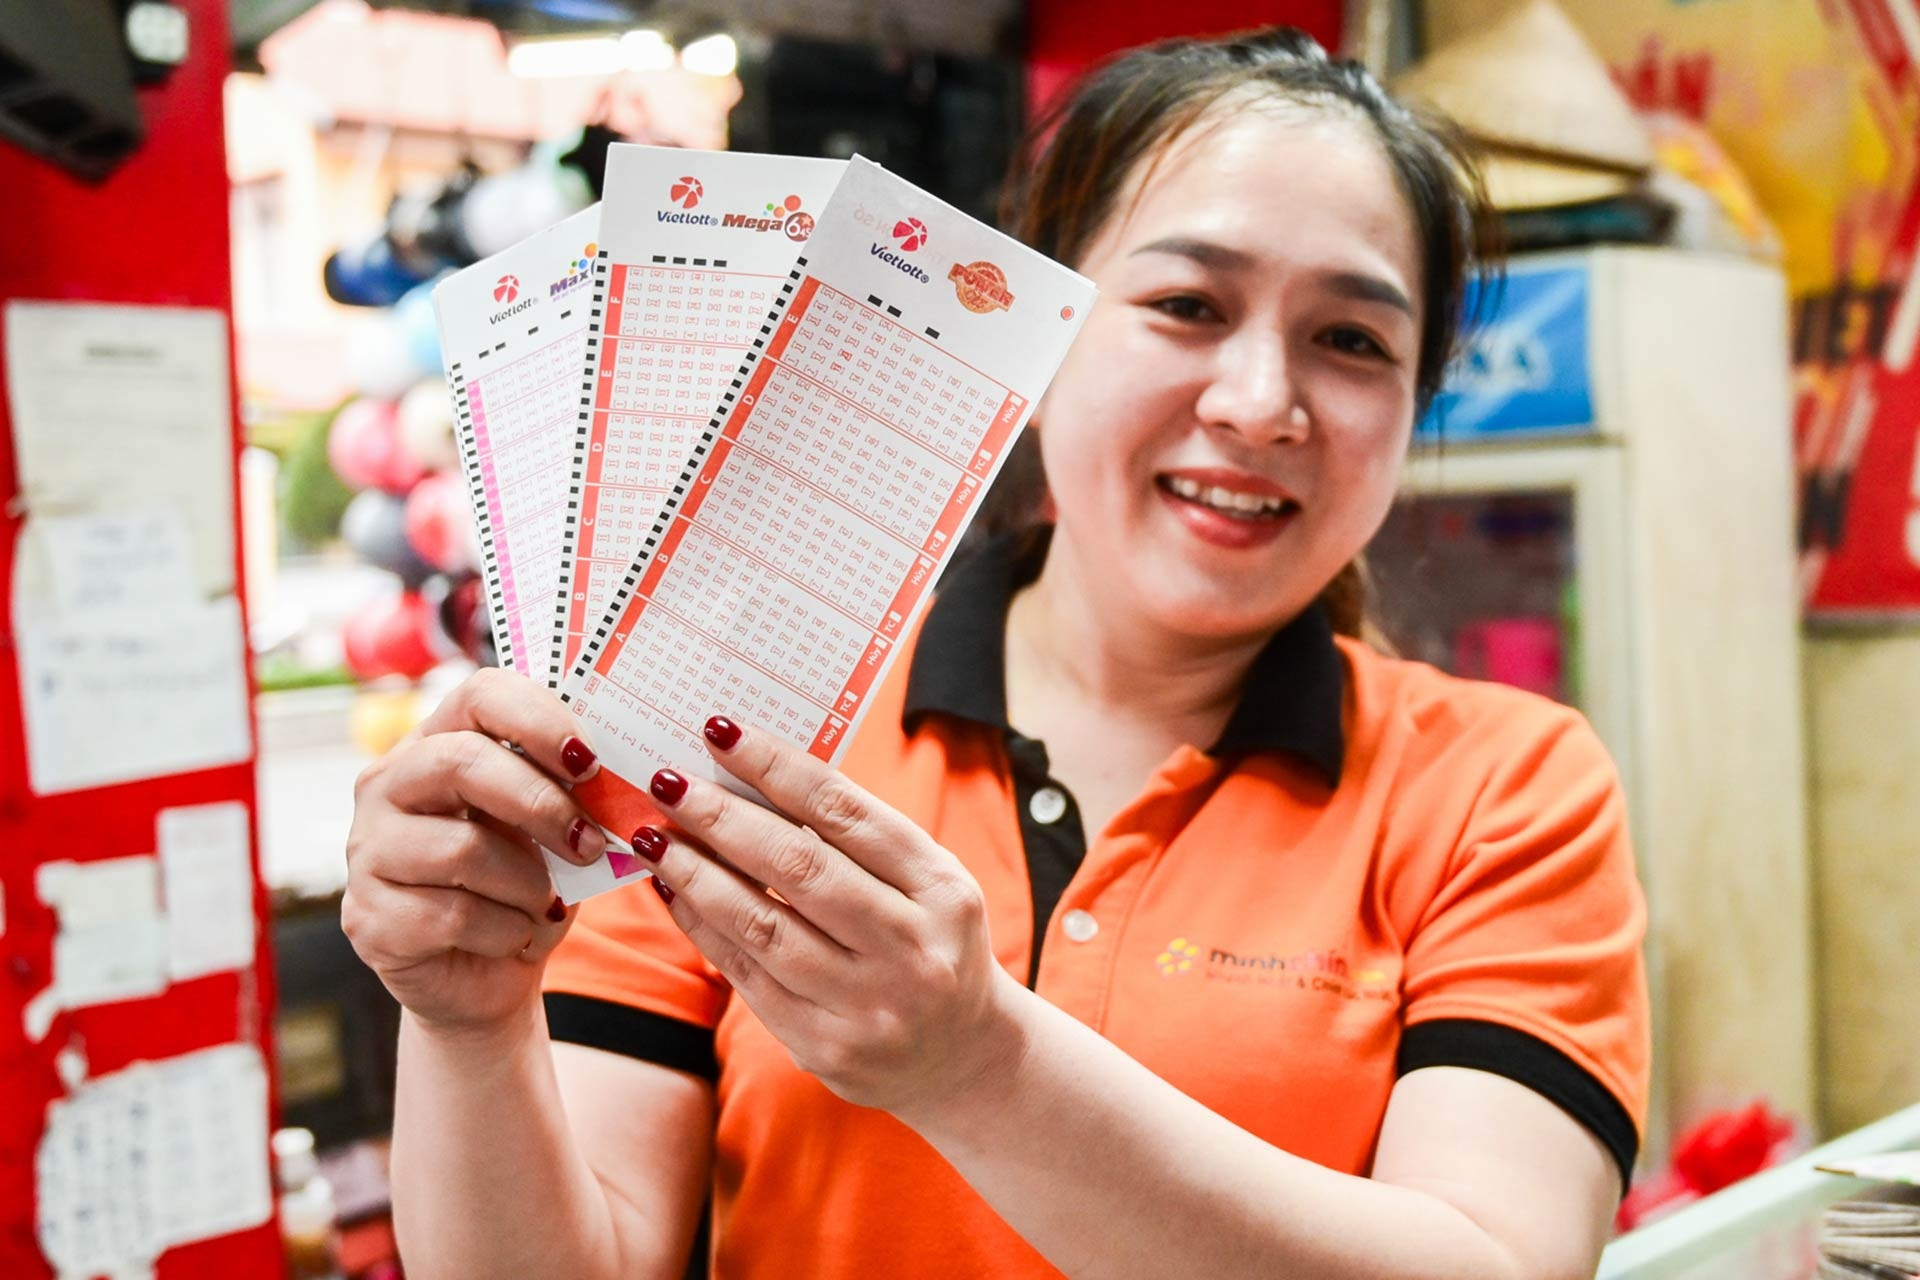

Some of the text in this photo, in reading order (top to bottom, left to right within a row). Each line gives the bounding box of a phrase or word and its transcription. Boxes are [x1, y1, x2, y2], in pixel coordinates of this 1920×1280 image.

[721, 213, 784, 233] Mega
[549, 268, 590, 297] Max
[610, 296, 622, 304] F
[786, 313, 799, 324] E
[601, 369, 613, 378] E
[742, 394, 754, 406] D
[591, 442, 603, 453] D
[973, 458, 987, 472] TC
[700, 474, 712, 485] C
[583, 517, 594, 526] C
[928, 538, 942, 553] TC
[657, 553, 669, 564] B
[573, 592, 585, 601] B
[883, 619, 897, 633] TC
[615, 632, 627, 643] A
[839, 699, 852, 713] TC
